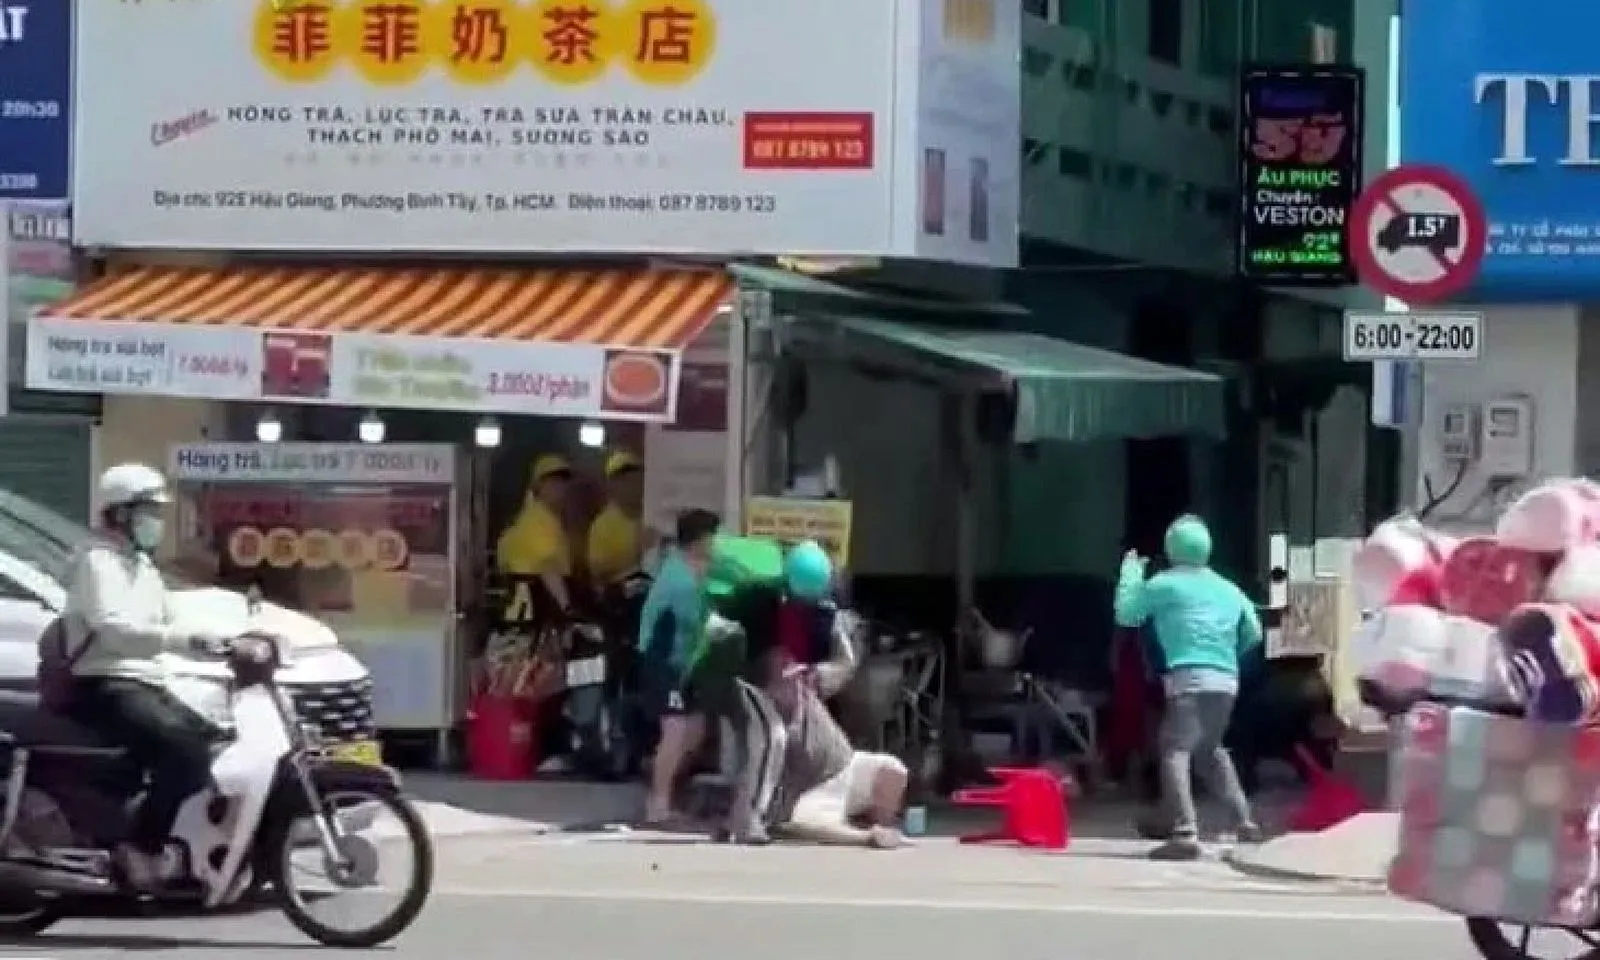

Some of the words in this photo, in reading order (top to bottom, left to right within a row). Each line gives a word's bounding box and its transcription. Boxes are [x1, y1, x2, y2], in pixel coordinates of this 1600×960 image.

[272, 4, 697, 64] 菲菲奶茶店
[659, 194, 691, 211] 087
[696, 194, 742, 212] 8789
[745, 195, 776, 213] 123
[1253, 205, 1345, 226] VESTON
